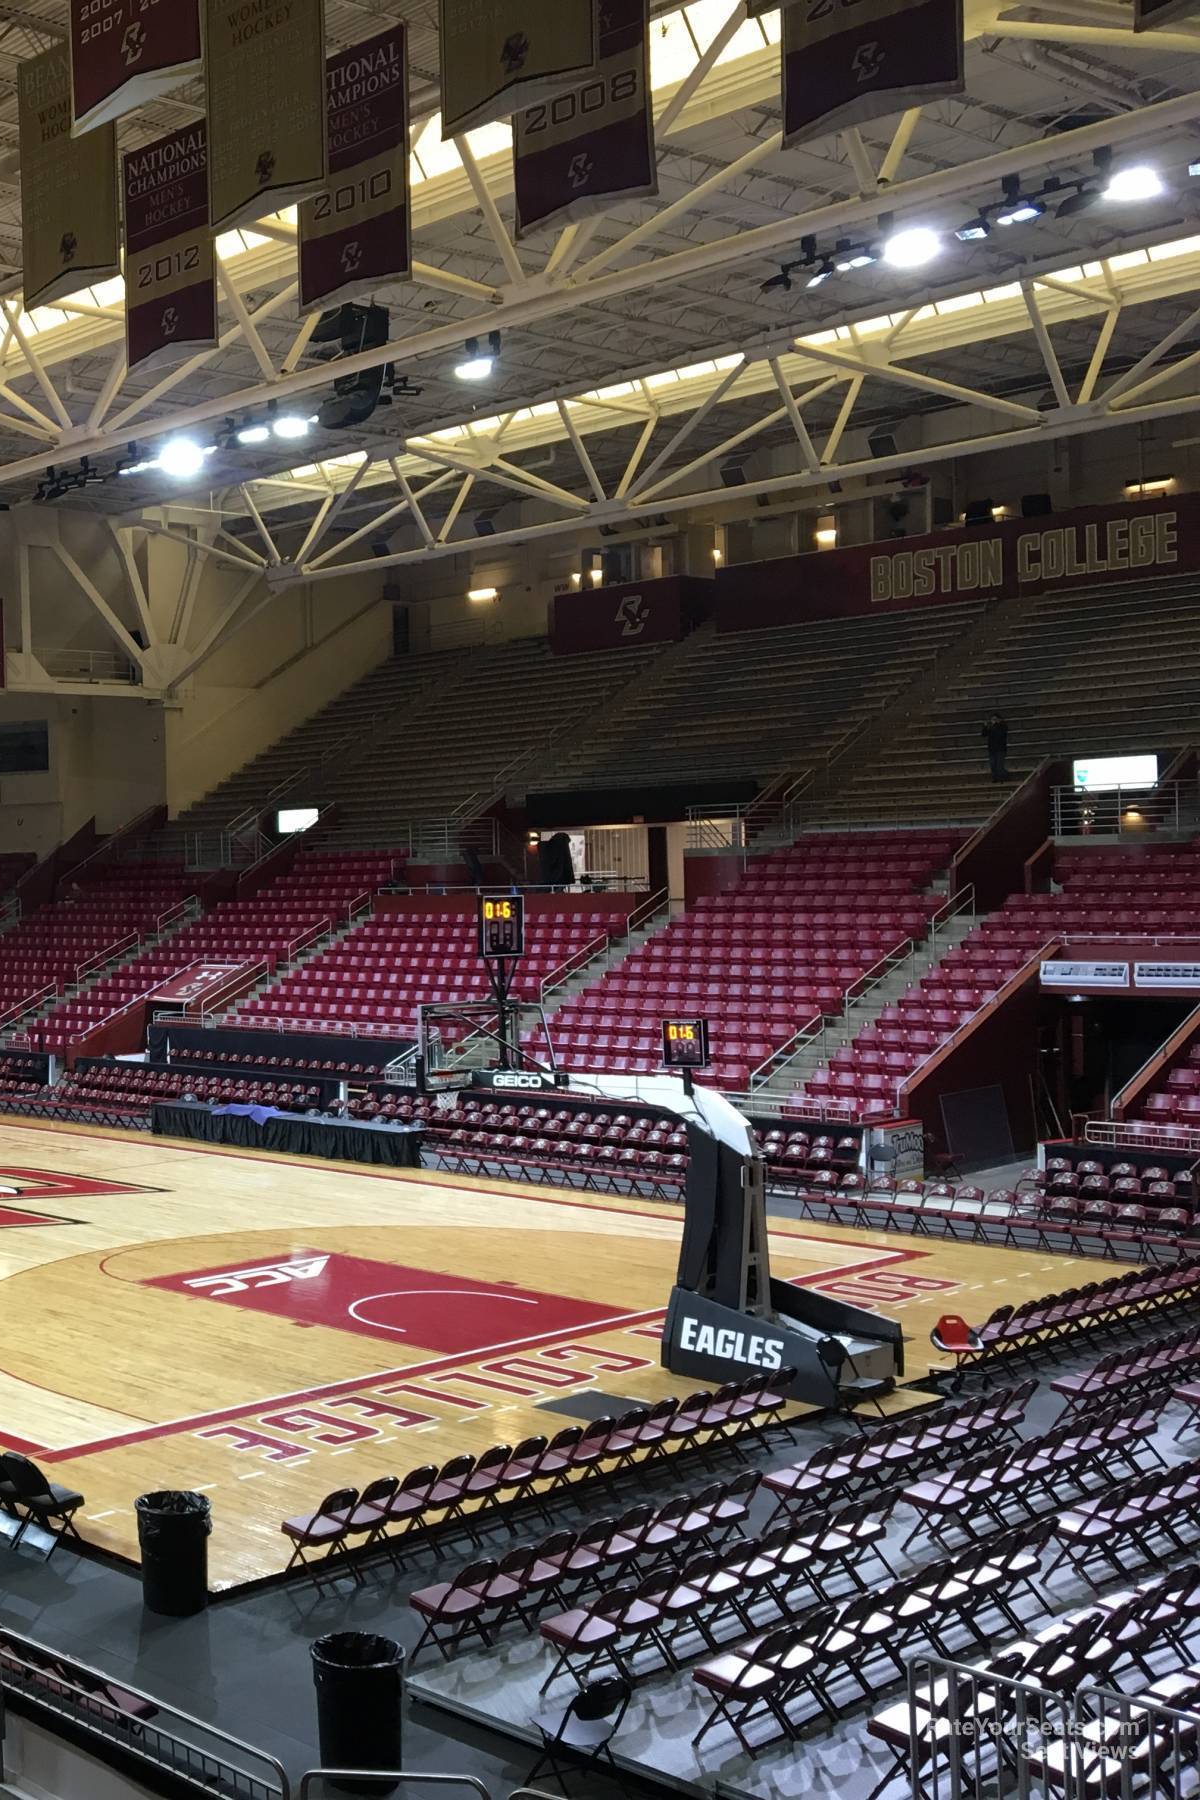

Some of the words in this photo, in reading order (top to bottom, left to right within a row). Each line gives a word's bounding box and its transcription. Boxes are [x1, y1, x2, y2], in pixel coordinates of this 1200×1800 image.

[81, 9, 123, 44] 2007
[232, 5, 293, 47] HOCKEY
[327, 63, 400, 110] AMPIONS
[328, 40, 400, 90] TIONAL
[524, 69, 637, 136] 2008
[127, 129, 207, 180] NATIONAL
[128, 150, 207, 197] CHAMPIONS
[145, 197, 191, 227] HOCKEY
[149, 184, 185, 209] MEN'S
[314, 168, 392, 220] 2010
[138, 245, 200, 288] 2012
[870, 538, 1003, 602] BOSTON
[1017, 511, 1178, 583] COLLEGE
[493, 1074, 542, 1088] GEICO
[183, 1255, 331, 1296] ACC
[680, 1316, 785, 1370] EAGLES
[192, 1344, 655, 1463] COLLEGE
